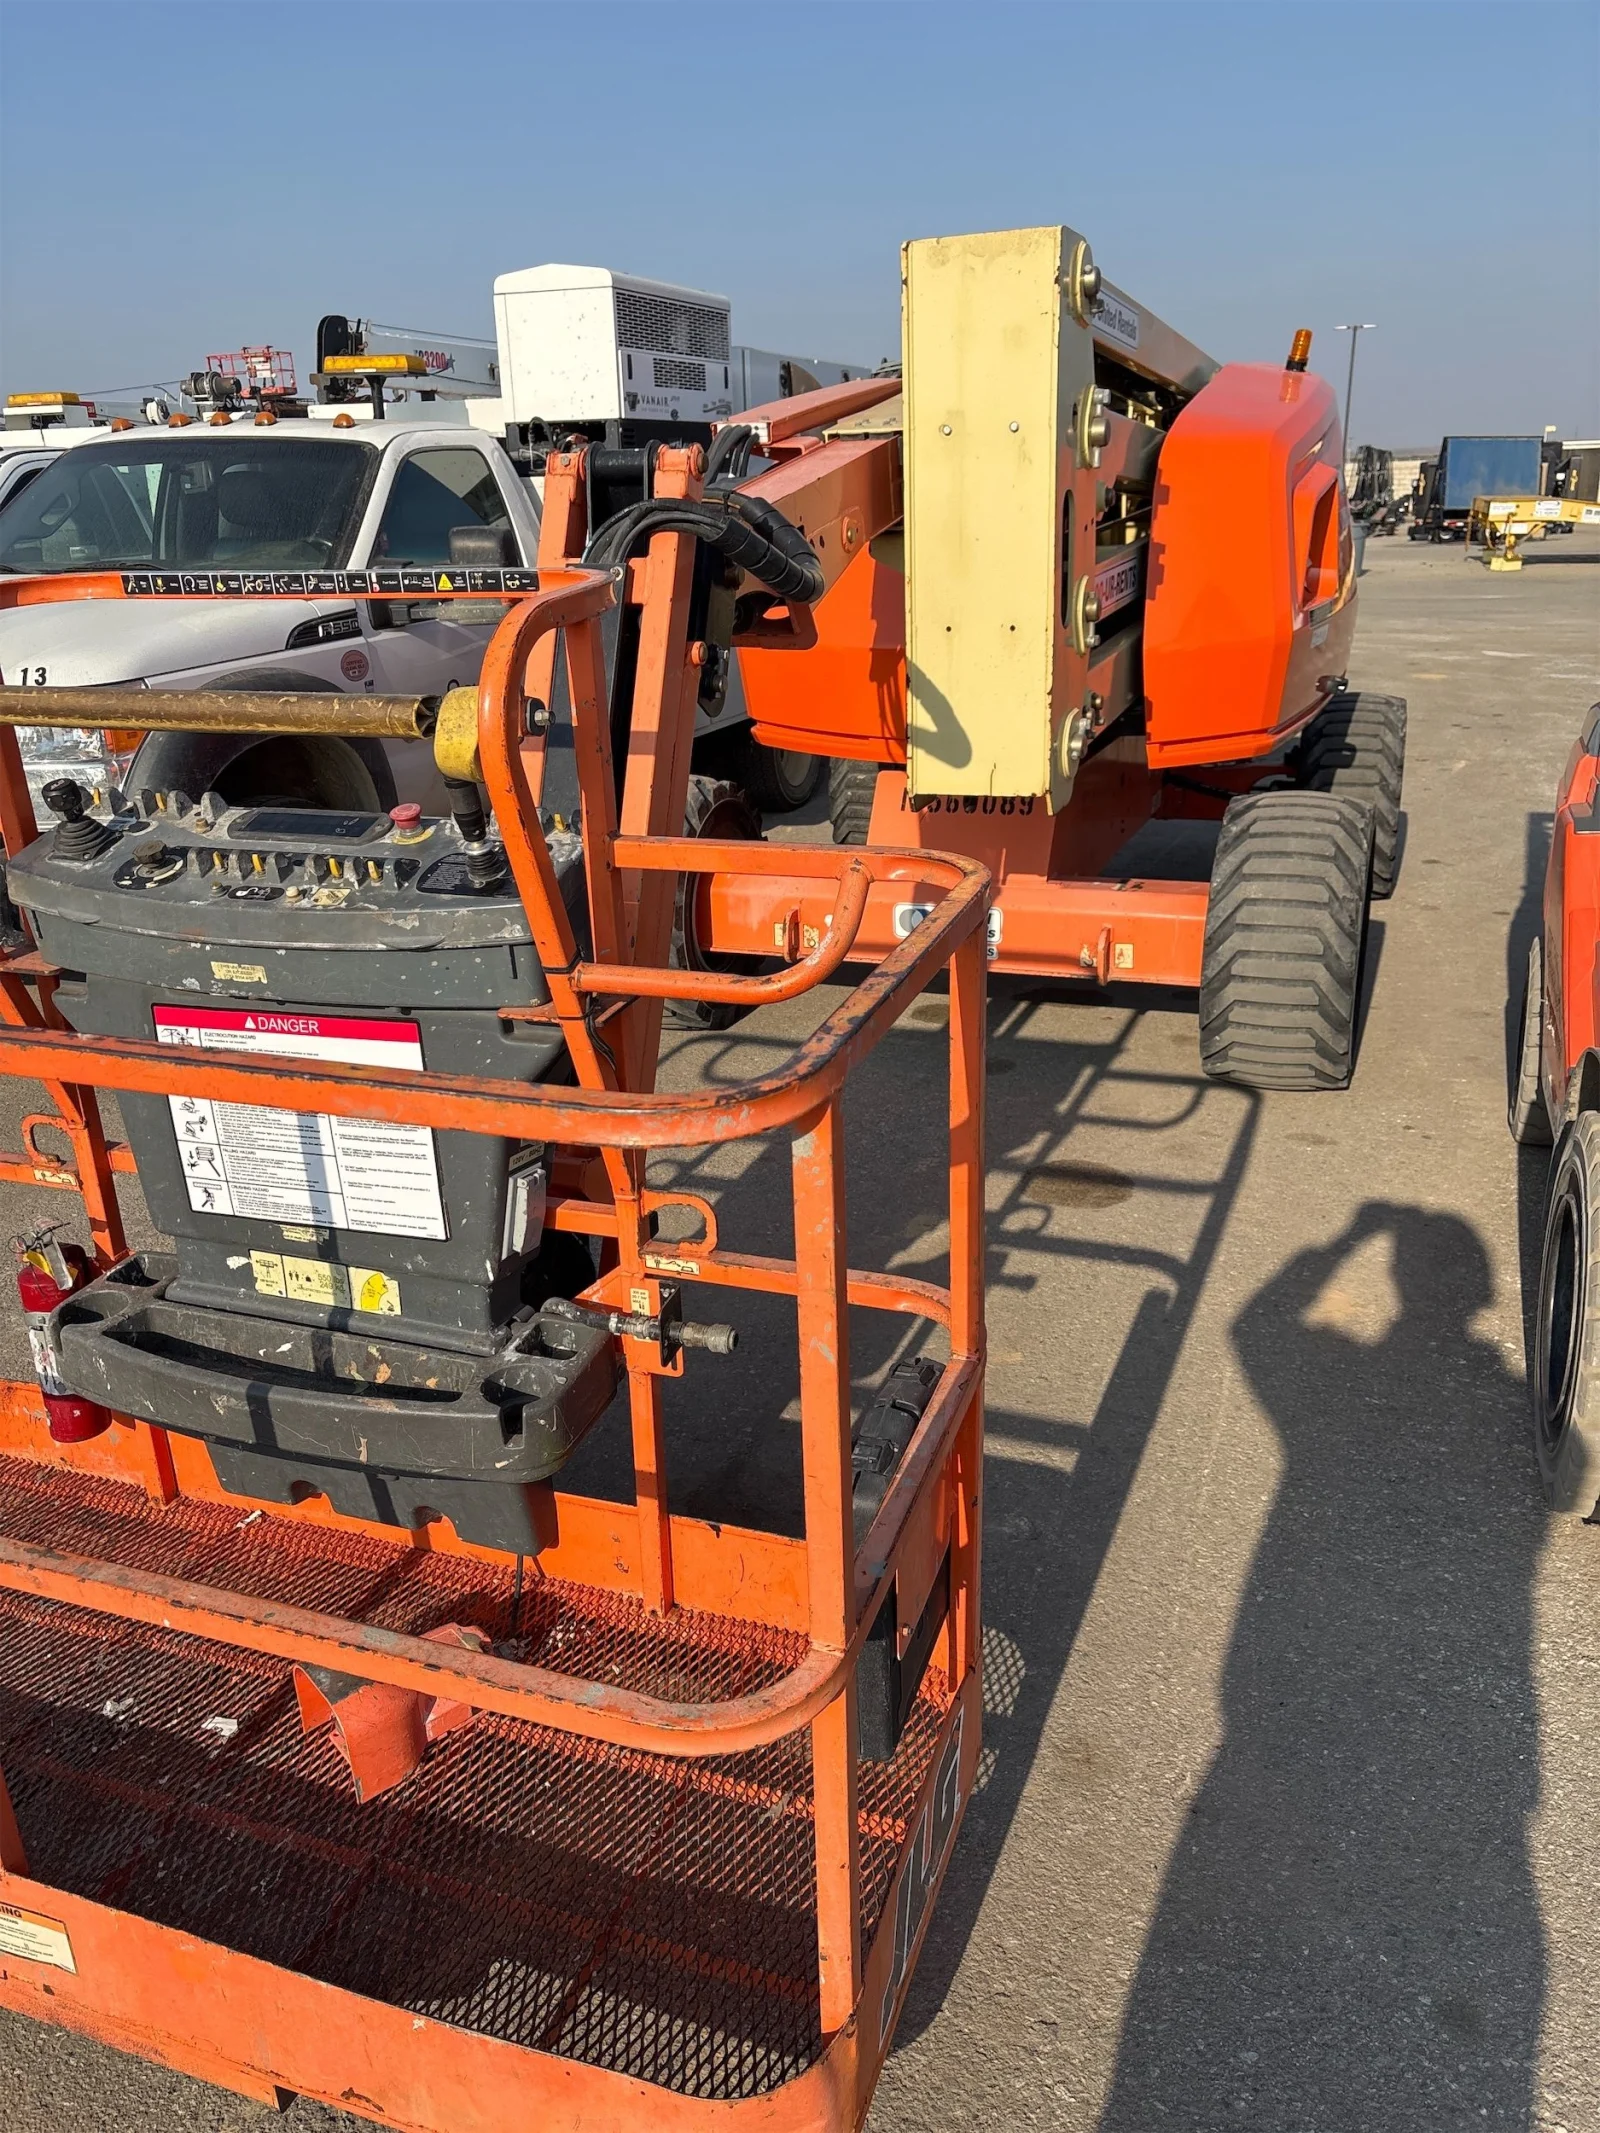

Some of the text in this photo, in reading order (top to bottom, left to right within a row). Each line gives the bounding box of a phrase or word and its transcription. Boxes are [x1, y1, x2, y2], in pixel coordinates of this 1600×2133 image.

[1117, 309, 1137, 341] Rentals
[641, 394, 669, 407] VANAIR
[257, 1016, 320, 1034] DANGER
